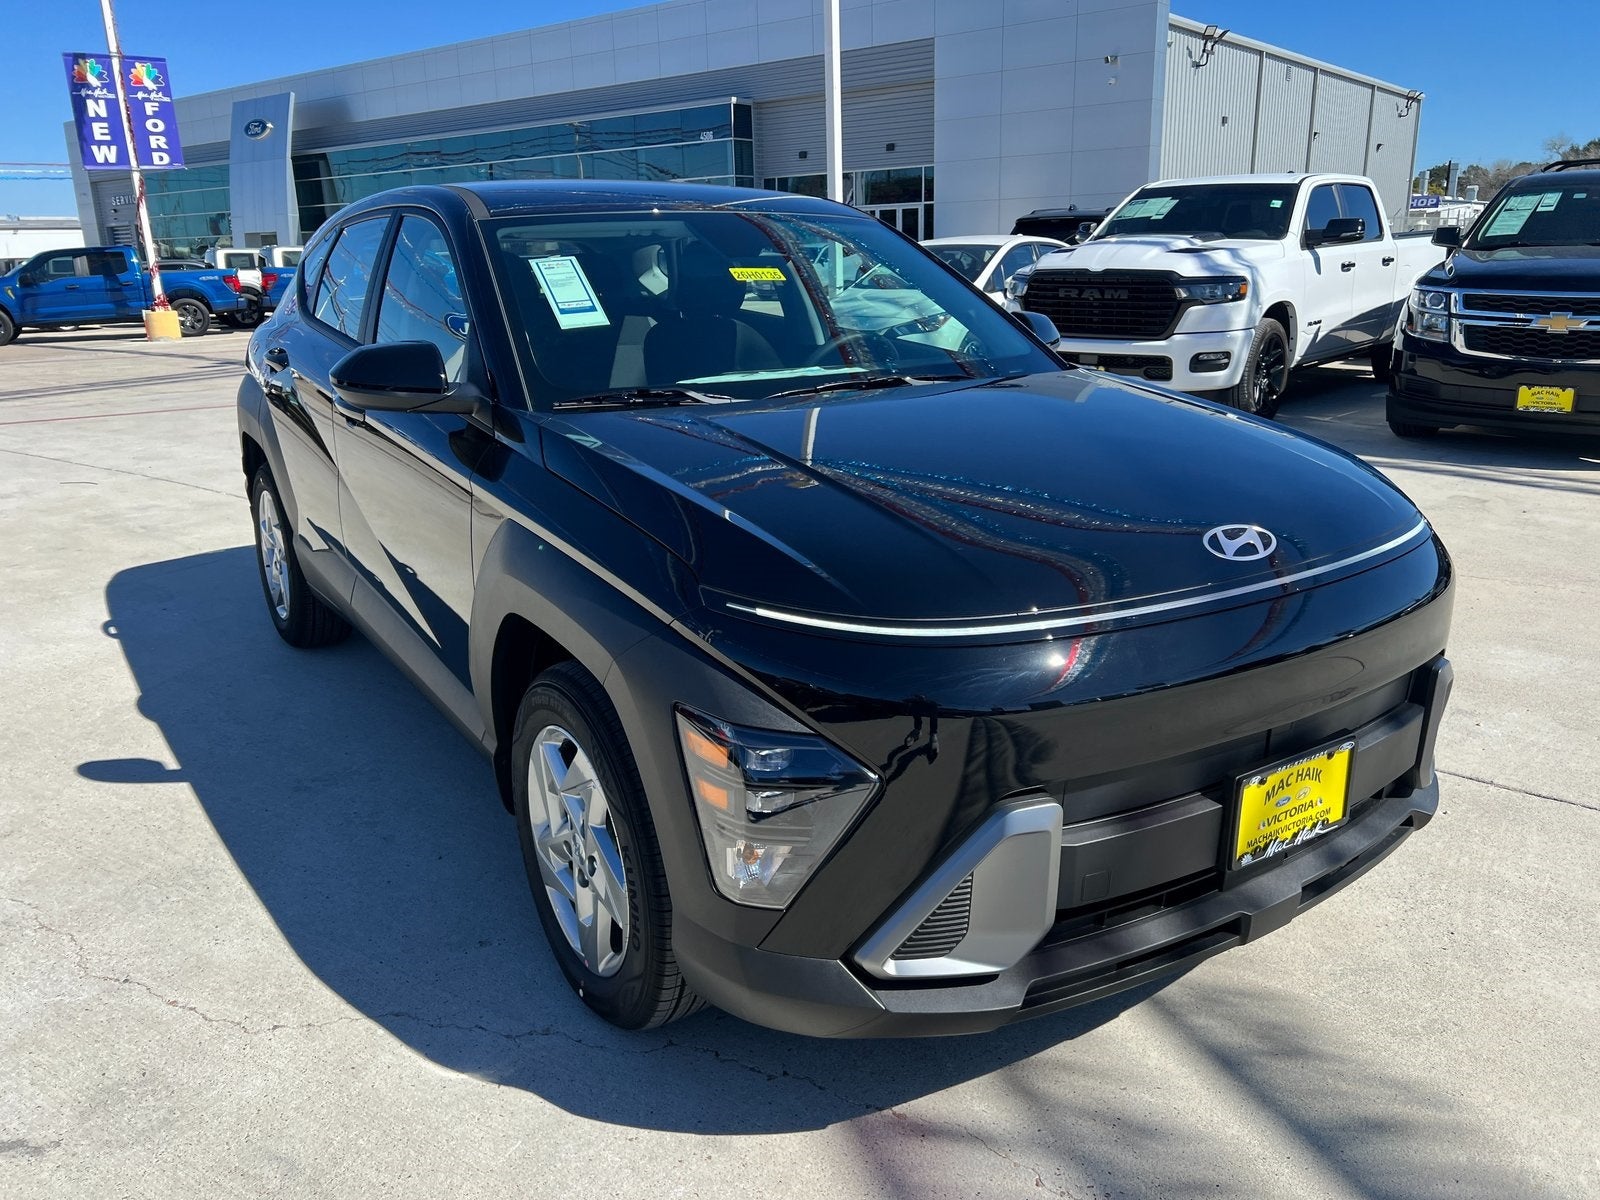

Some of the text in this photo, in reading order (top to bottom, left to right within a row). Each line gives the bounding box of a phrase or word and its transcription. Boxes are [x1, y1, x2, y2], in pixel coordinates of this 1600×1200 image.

[86, 99, 117, 163] NEW
[144, 102, 170, 165] FORD
[111, 195, 136, 206] SERVIC
[1410, 198, 1437, 207] HOP
[734, 271, 782, 280] 26H0135
[1058, 288, 1129, 299] RAM
[1264, 766, 1323, 806] MAC HAIK
[1266, 800, 1314, 827] VICTORIA
[1246, 807, 1331, 848] MACHAIKVICTORIA.COM
